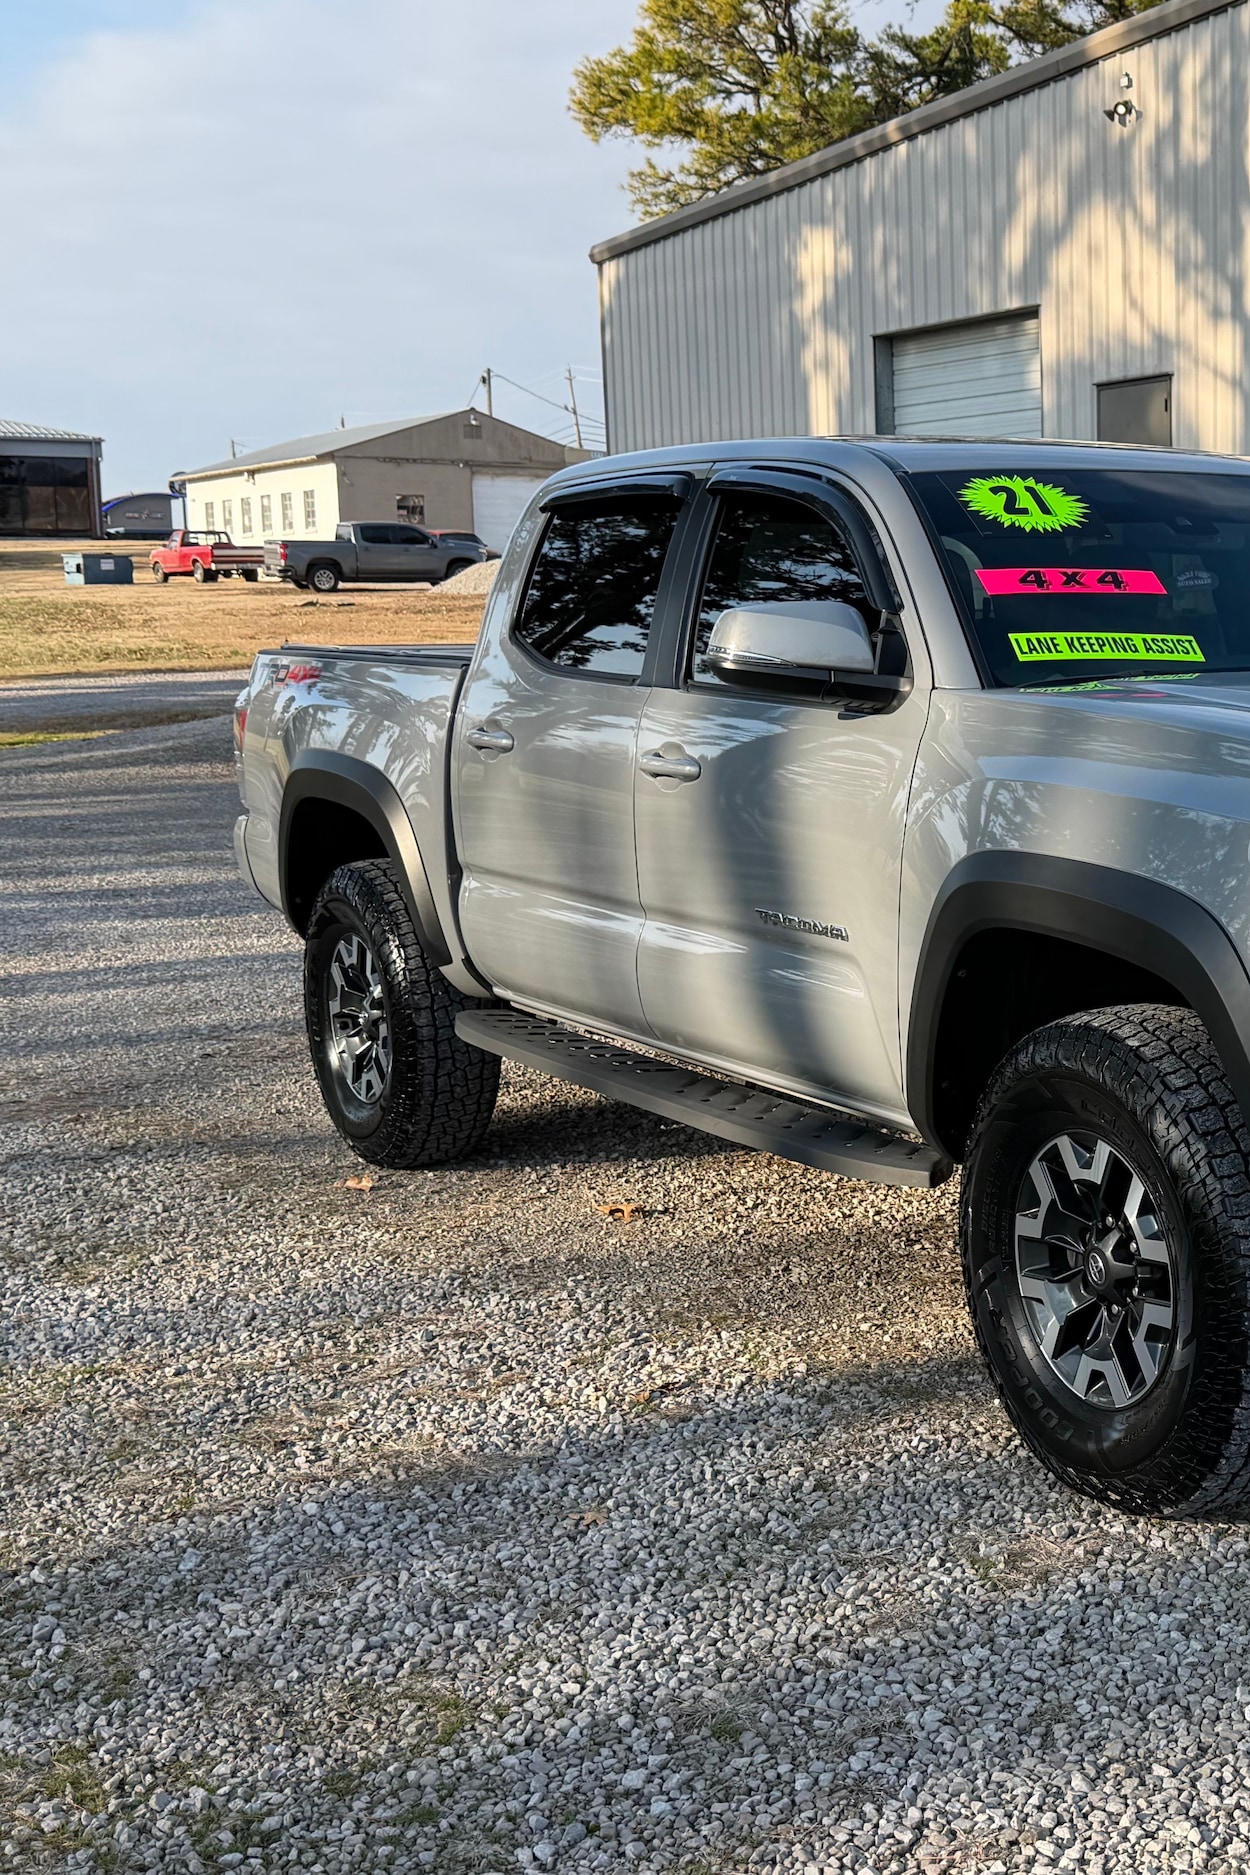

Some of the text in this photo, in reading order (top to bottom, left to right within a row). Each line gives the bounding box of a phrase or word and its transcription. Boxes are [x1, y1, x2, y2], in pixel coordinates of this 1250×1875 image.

[988, 485, 1058, 518] 21
[1014, 636, 1199, 656] LANE KEEPING ASSIST
[755, 908, 849, 942] TACOMA
